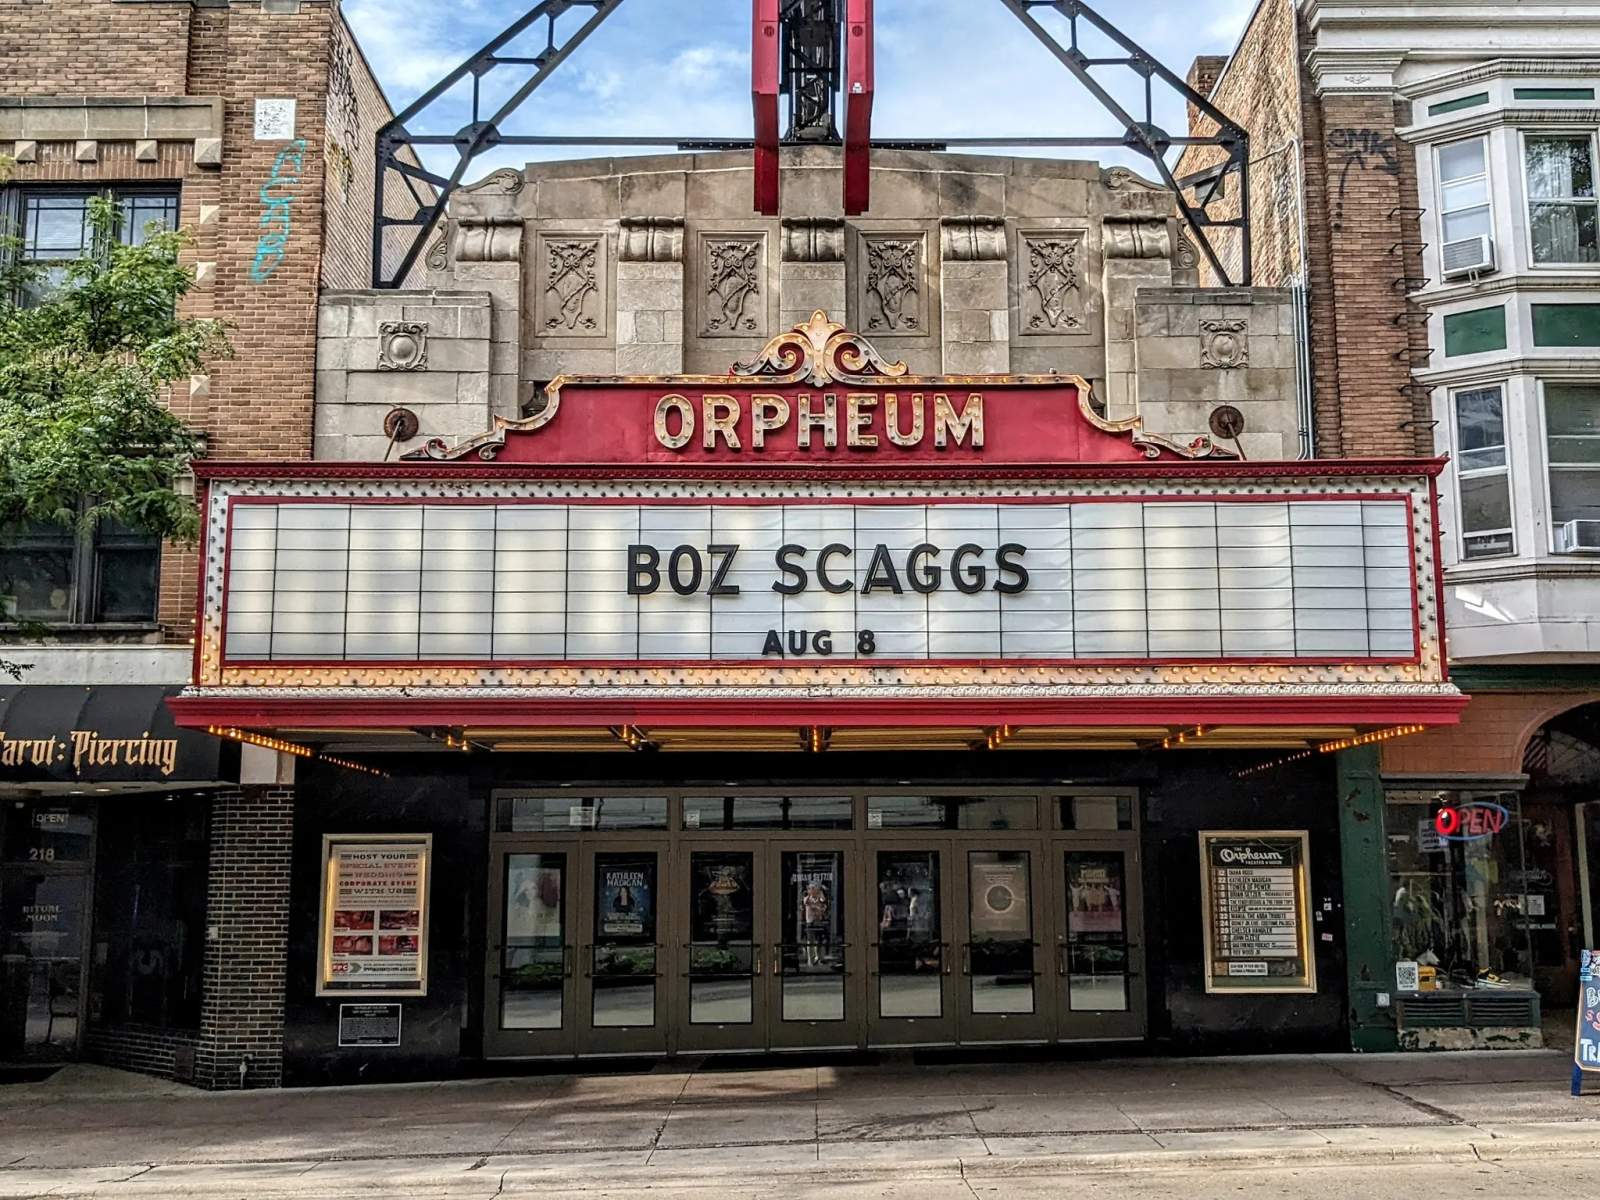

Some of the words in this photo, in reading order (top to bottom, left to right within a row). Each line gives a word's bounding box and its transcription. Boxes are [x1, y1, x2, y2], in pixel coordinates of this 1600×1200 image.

[653, 393, 985, 449] ORPHEUM
[627, 544, 740, 595] BOZ
[771, 543, 1030, 595] SCAGGS
[761, 629, 833, 656] AUG
[857, 629, 876, 655] 8
[70, 730, 178, 776] Piercing
[36, 813, 65, 823] OPEN
[1435, 806, 1502, 835] OPEN
[29, 848, 55, 861] 218
[1220, 848, 1284, 863] Orpheum
